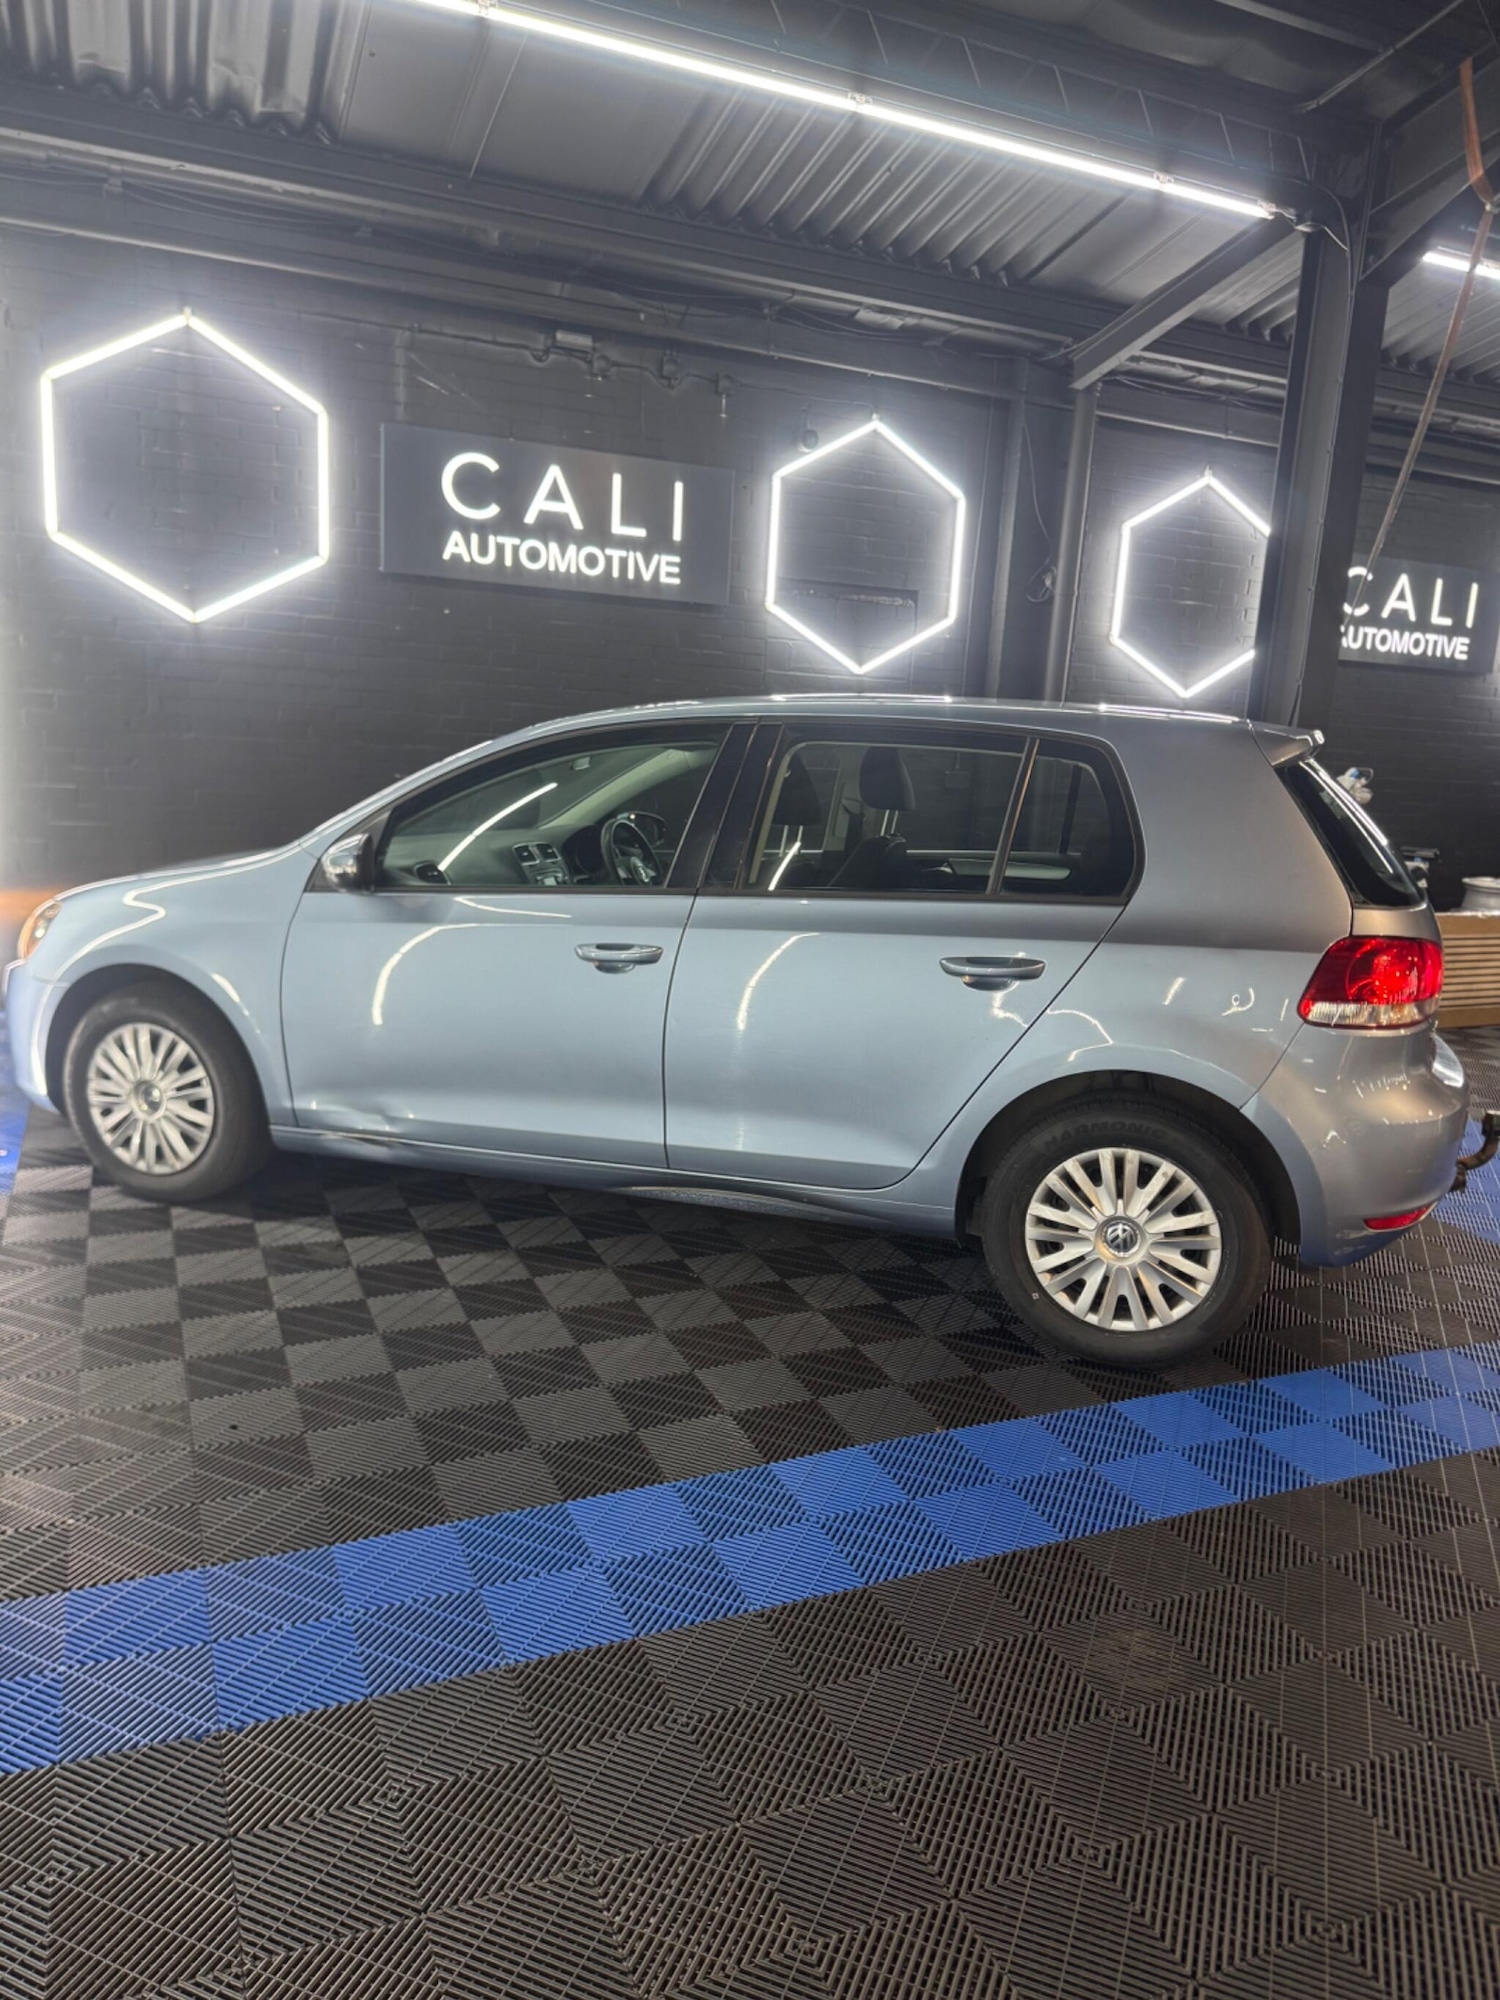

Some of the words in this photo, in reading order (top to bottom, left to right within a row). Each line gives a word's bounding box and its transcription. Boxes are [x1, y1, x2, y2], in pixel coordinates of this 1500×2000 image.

[441, 452, 684, 542] CALI
[442, 530, 682, 585] AUTOMOTIVE
[1044, 1120, 1169, 1152] HARMONIC
